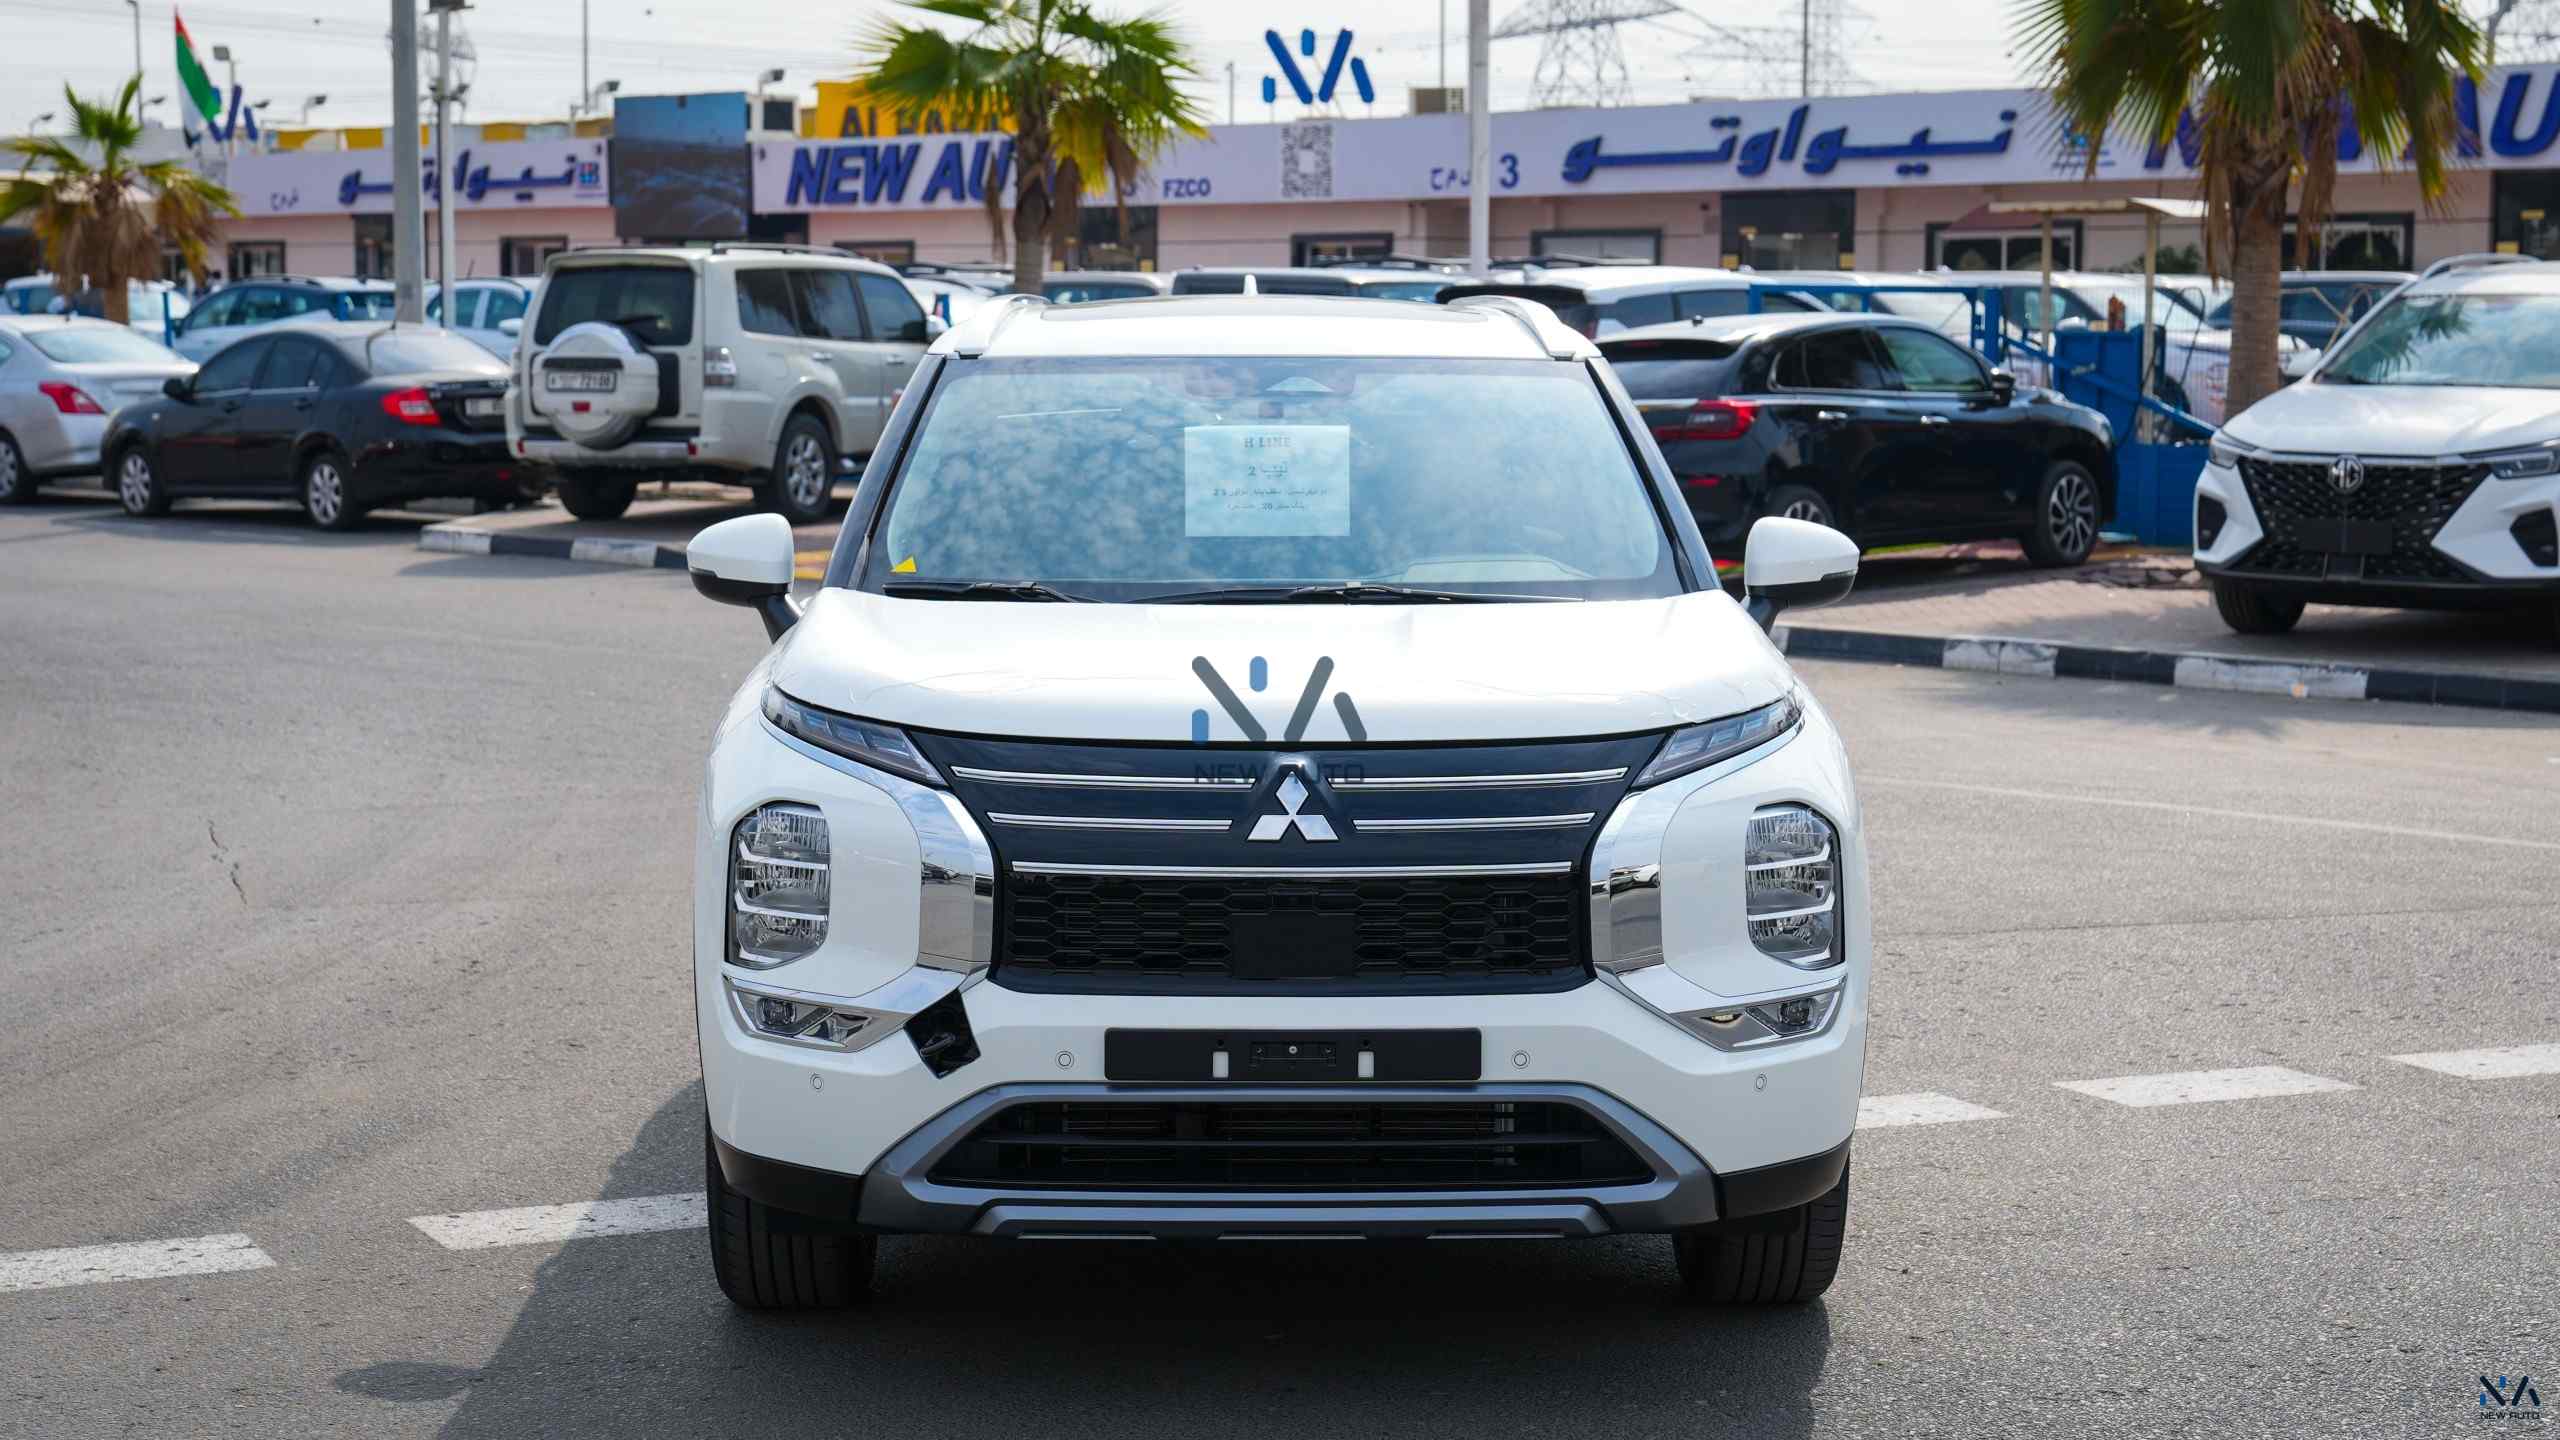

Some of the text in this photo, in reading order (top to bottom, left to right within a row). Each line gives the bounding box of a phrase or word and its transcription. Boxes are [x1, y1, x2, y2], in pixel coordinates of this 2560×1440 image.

[785, 142, 921, 206] NEW
[1163, 177, 1211, 198] FZCO
[1499, 153, 1519, 189] 3
